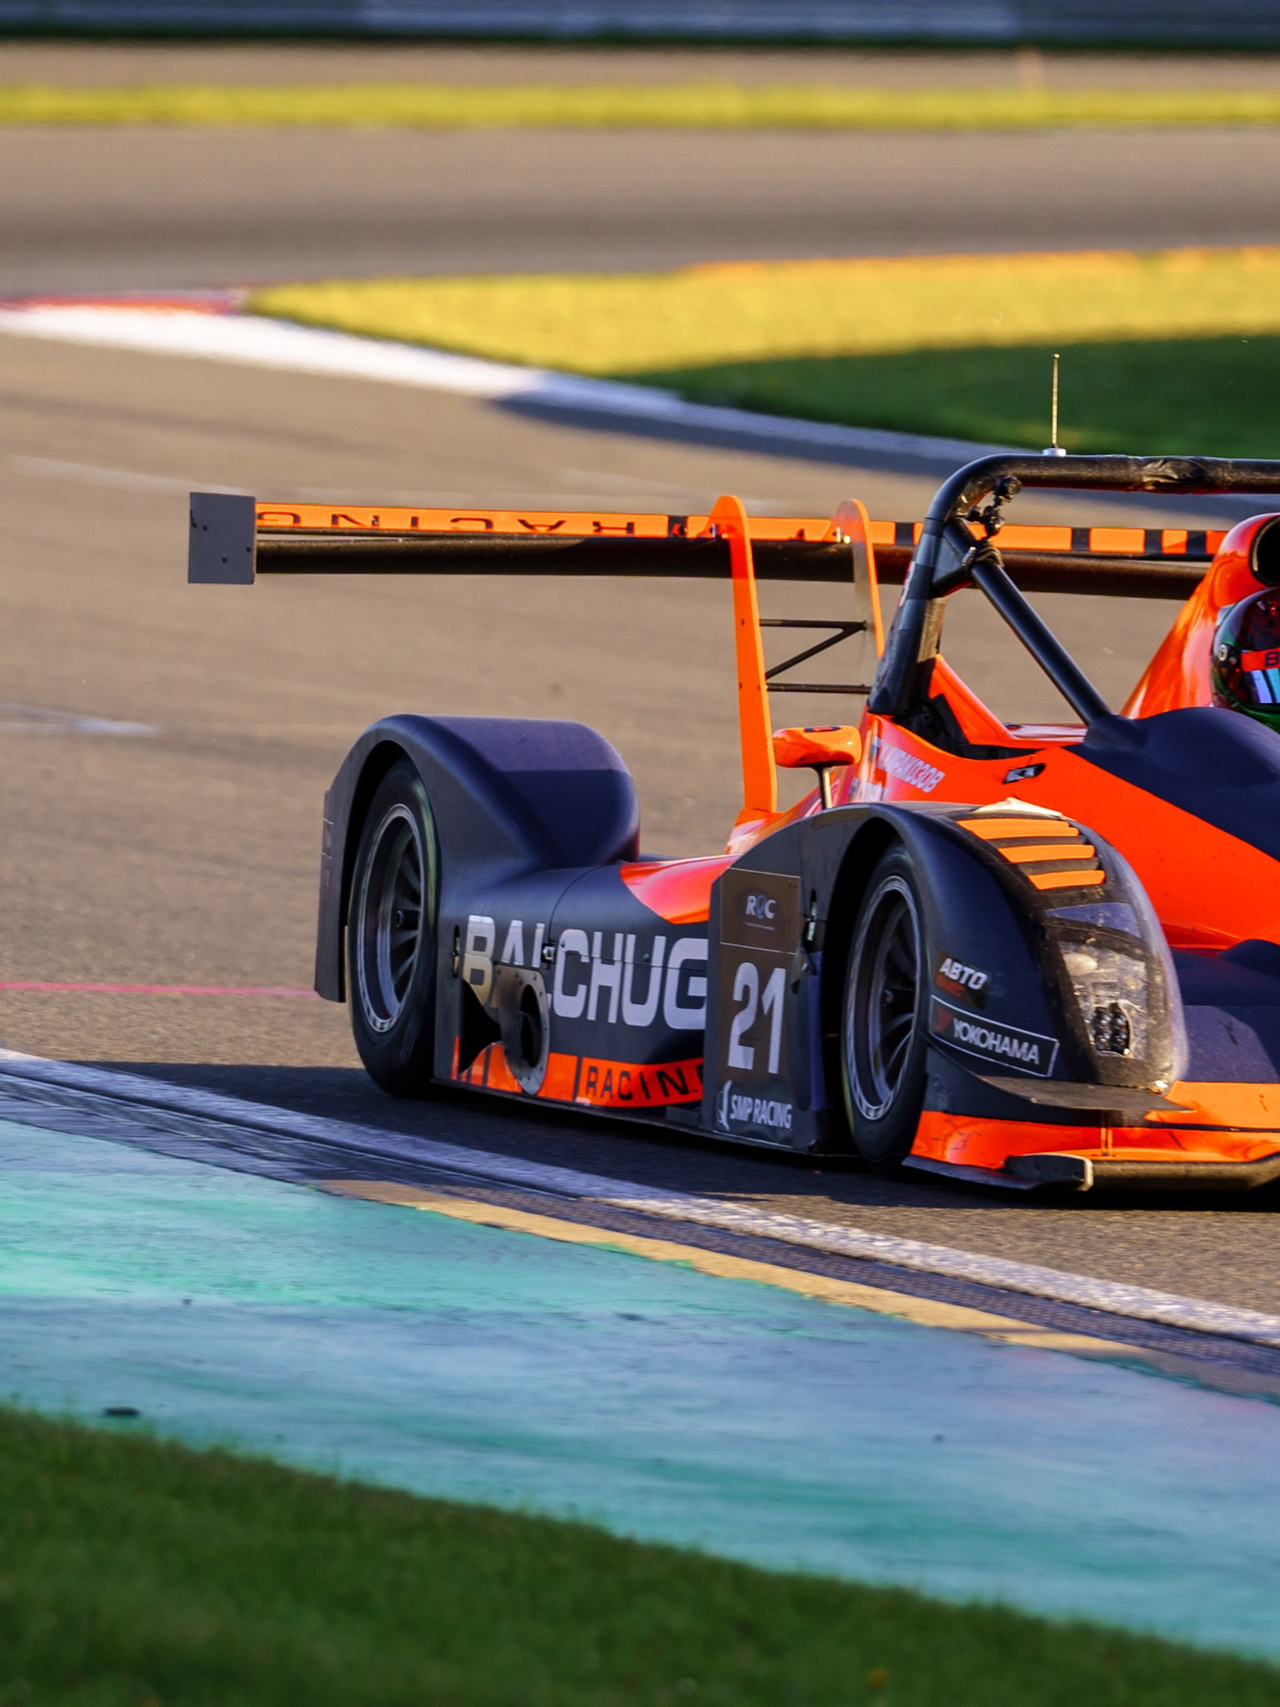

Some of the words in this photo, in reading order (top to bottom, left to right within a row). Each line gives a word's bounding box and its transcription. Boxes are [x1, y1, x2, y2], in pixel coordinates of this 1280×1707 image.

[256, 511, 635, 536] RACING
[727, 961, 787, 1075] 21
[952, 1017, 1041, 1066] YOKOHAMA
[730, 1094, 753, 1122] SMP
[753, 1098, 793, 1130] RACING
